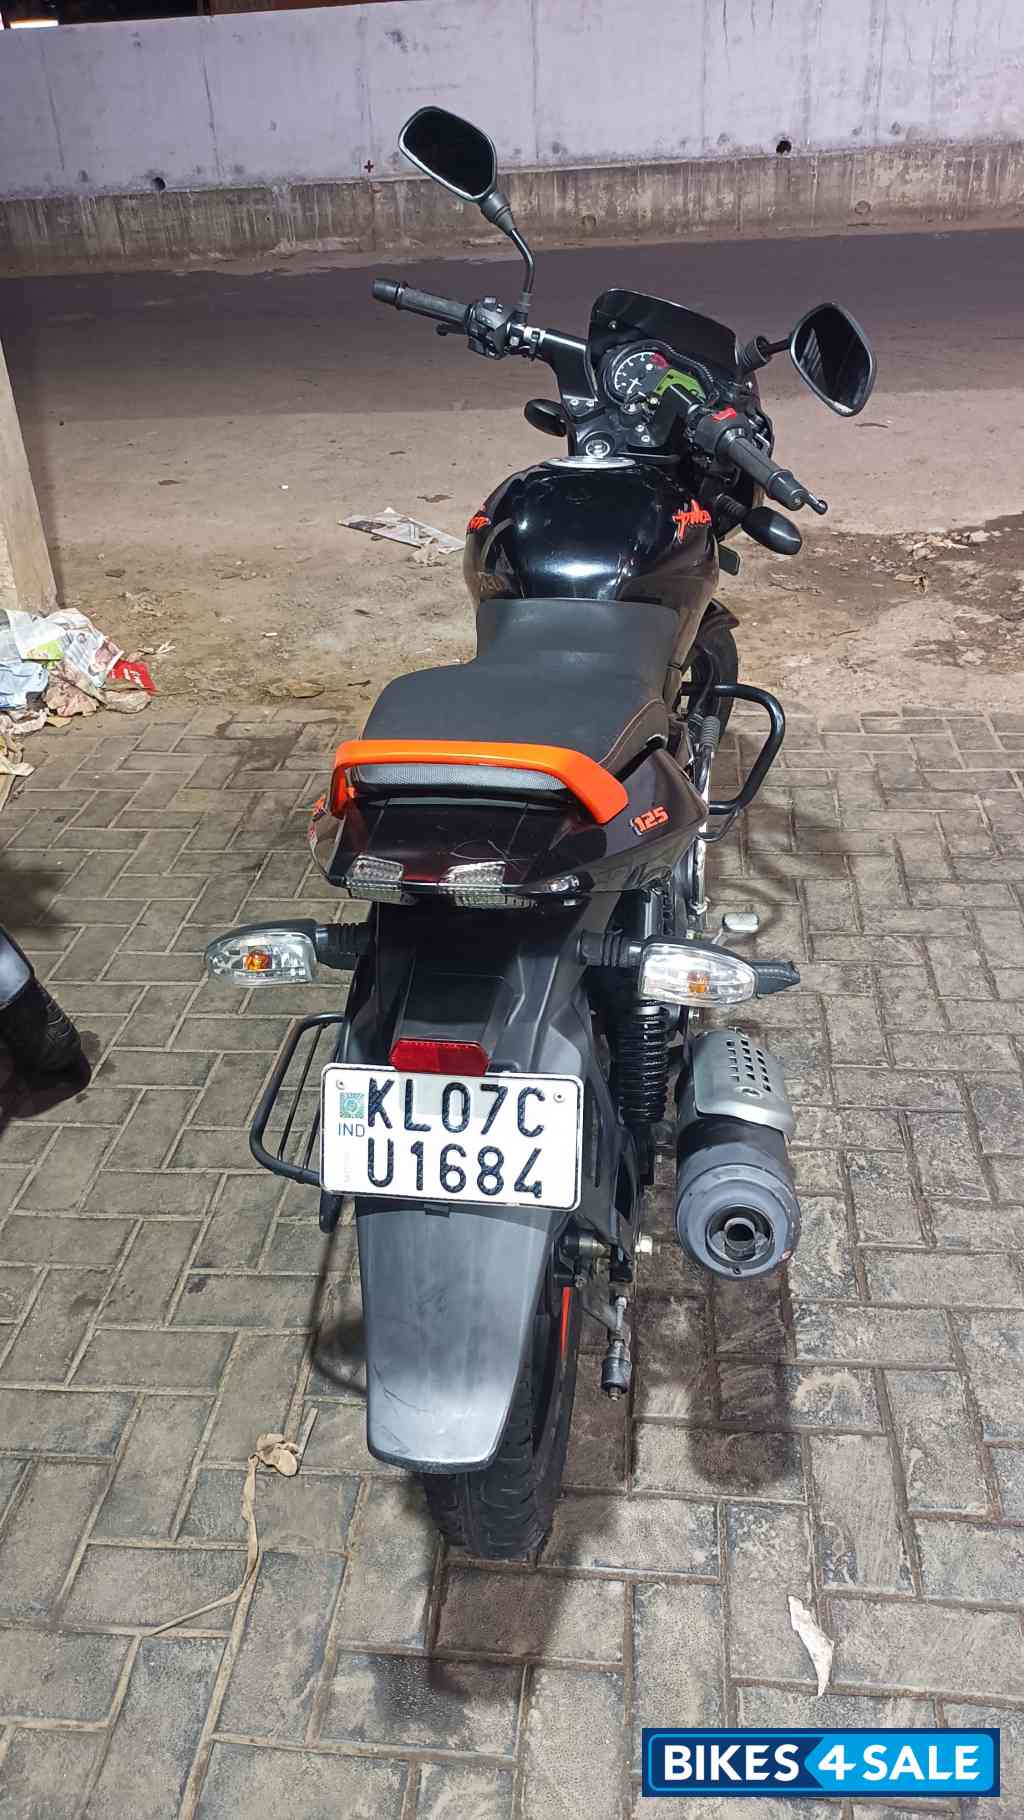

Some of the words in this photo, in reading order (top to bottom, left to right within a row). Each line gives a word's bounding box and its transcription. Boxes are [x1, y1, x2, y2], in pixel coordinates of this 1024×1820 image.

[634, 806, 668, 832] 125
[368, 1077, 545, 1137] KL07C
[338, 1122, 365, 1138] IND
[368, 1137, 542, 1198] U1684
